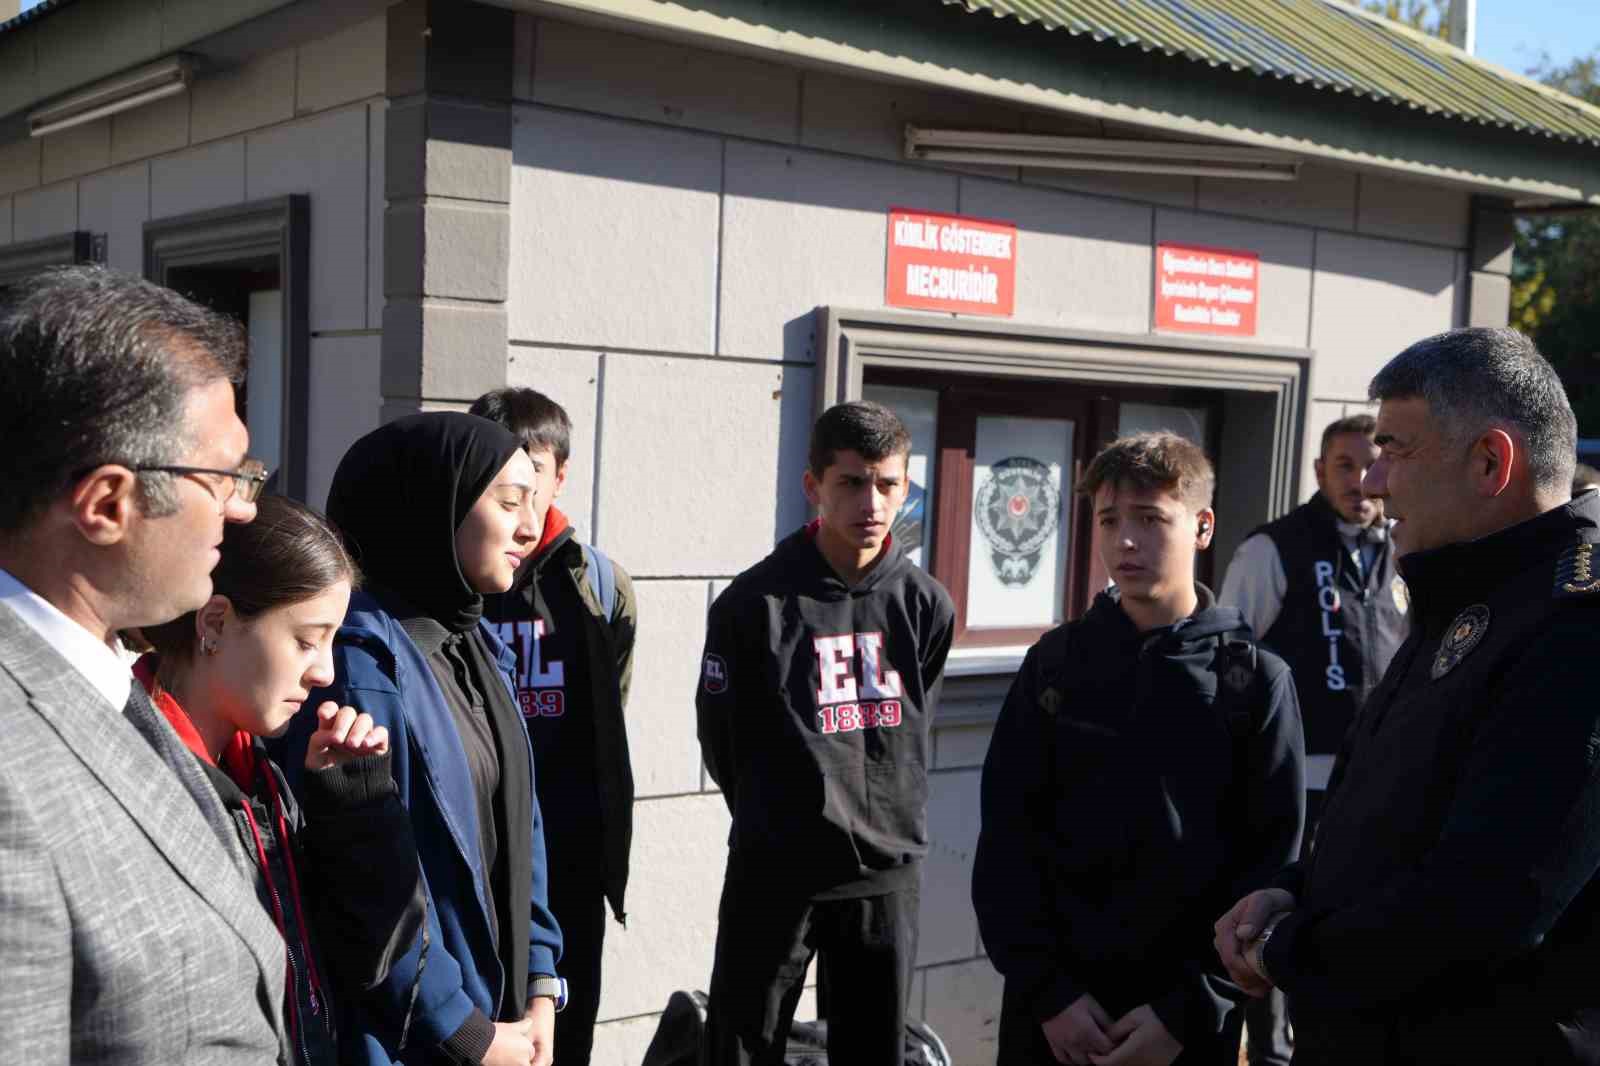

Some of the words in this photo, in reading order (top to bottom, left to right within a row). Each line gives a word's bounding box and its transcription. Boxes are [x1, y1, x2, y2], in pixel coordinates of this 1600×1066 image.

[906, 263, 998, 304] MECBURİDİR
[813, 631, 903, 705] EL
[818, 699, 902, 734] 1889
